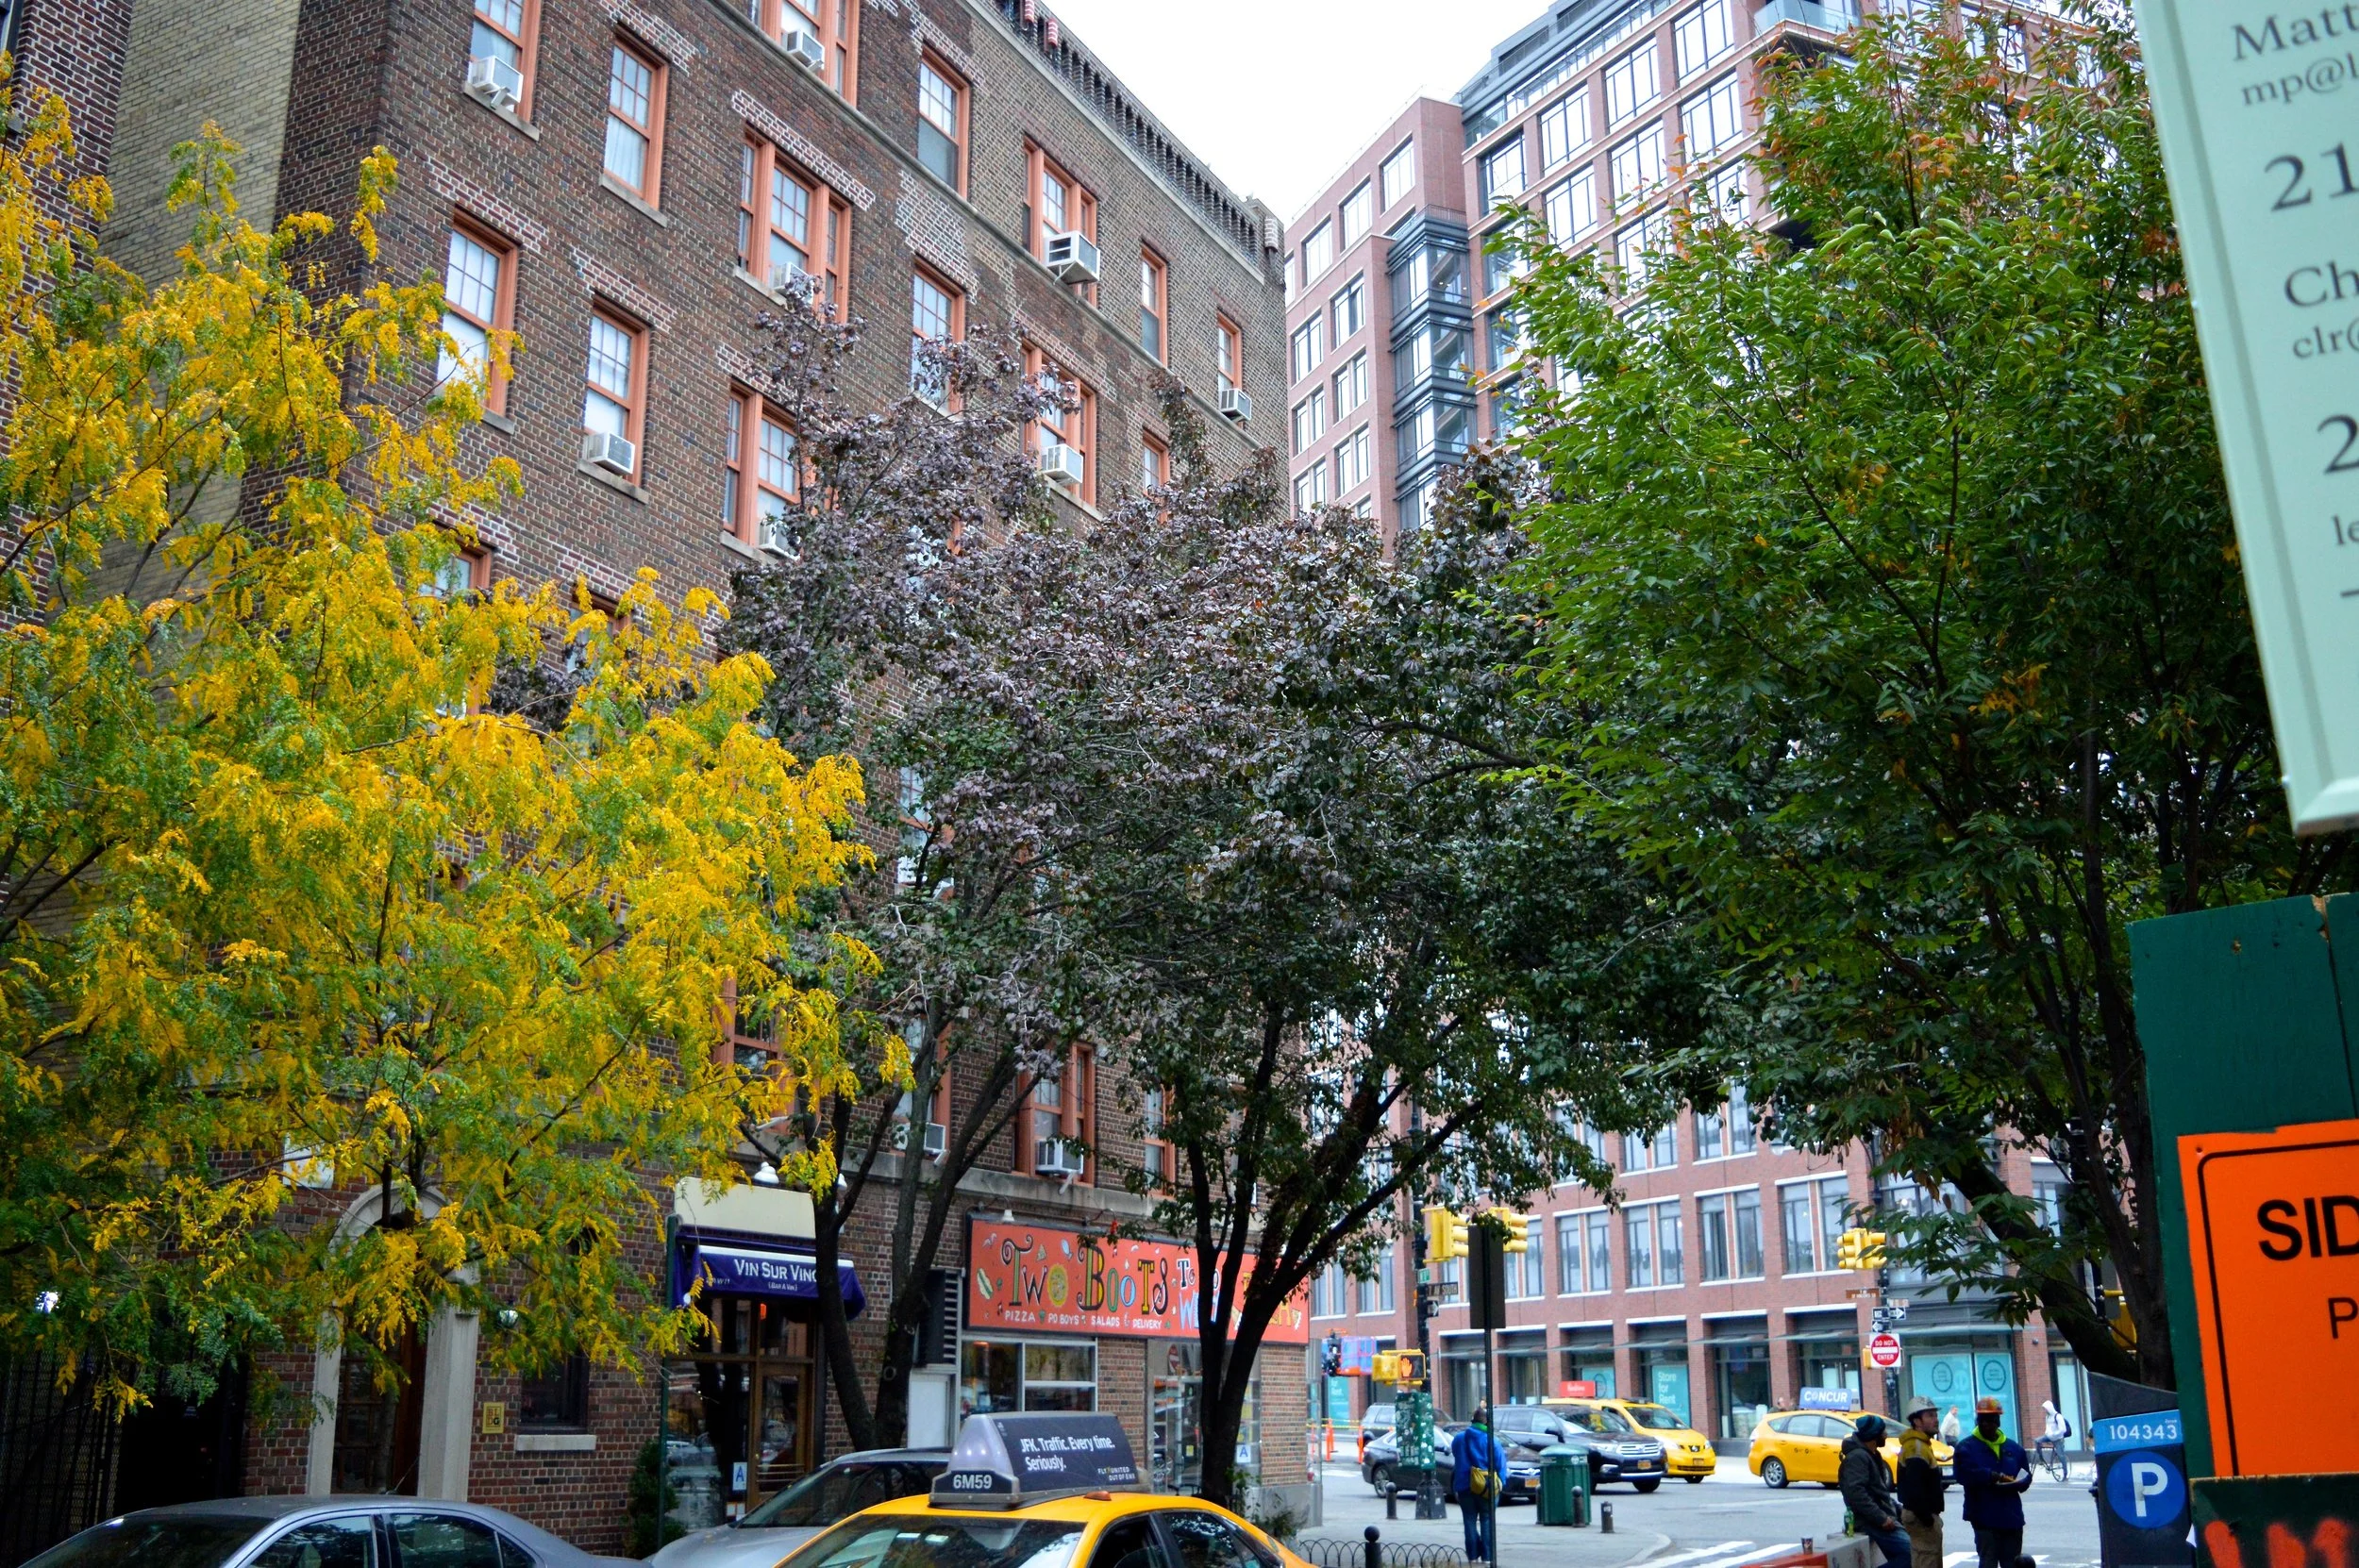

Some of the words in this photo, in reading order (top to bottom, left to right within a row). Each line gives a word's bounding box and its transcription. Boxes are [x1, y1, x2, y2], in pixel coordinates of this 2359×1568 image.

[2232, 3, 2359, 61] Matt
[2265, 141, 2359, 211] 21
[734, 1259, 759, 1276] VIN
[761, 1261, 787, 1279] SUR
[1004, 1309, 1036, 1322] PIZZA
[1060, 1313, 1079, 1326] BOYS
[1091, 1315, 1120, 1327] SALADS
[1132, 1318, 1163, 1329] DELIVERY
[1804, 1391, 1848, 1403] CONCUR
[2109, 1424, 2178, 1441] 104343
[1020, 1438, 1040, 1453] JFK.
[1038, 1437, 1069, 1453] Traffic.
[1068, 1436, 1094, 1452] Every
[1093, 1435, 1116, 1449] time.
[1239, 1445, 1248, 1458] A
[1025, 1456, 1067, 1473] Seriously.
[735, 1465, 745, 1482] A
[953, 1474, 993, 1490] 6M59
[2131, 1461, 2168, 1517] P
